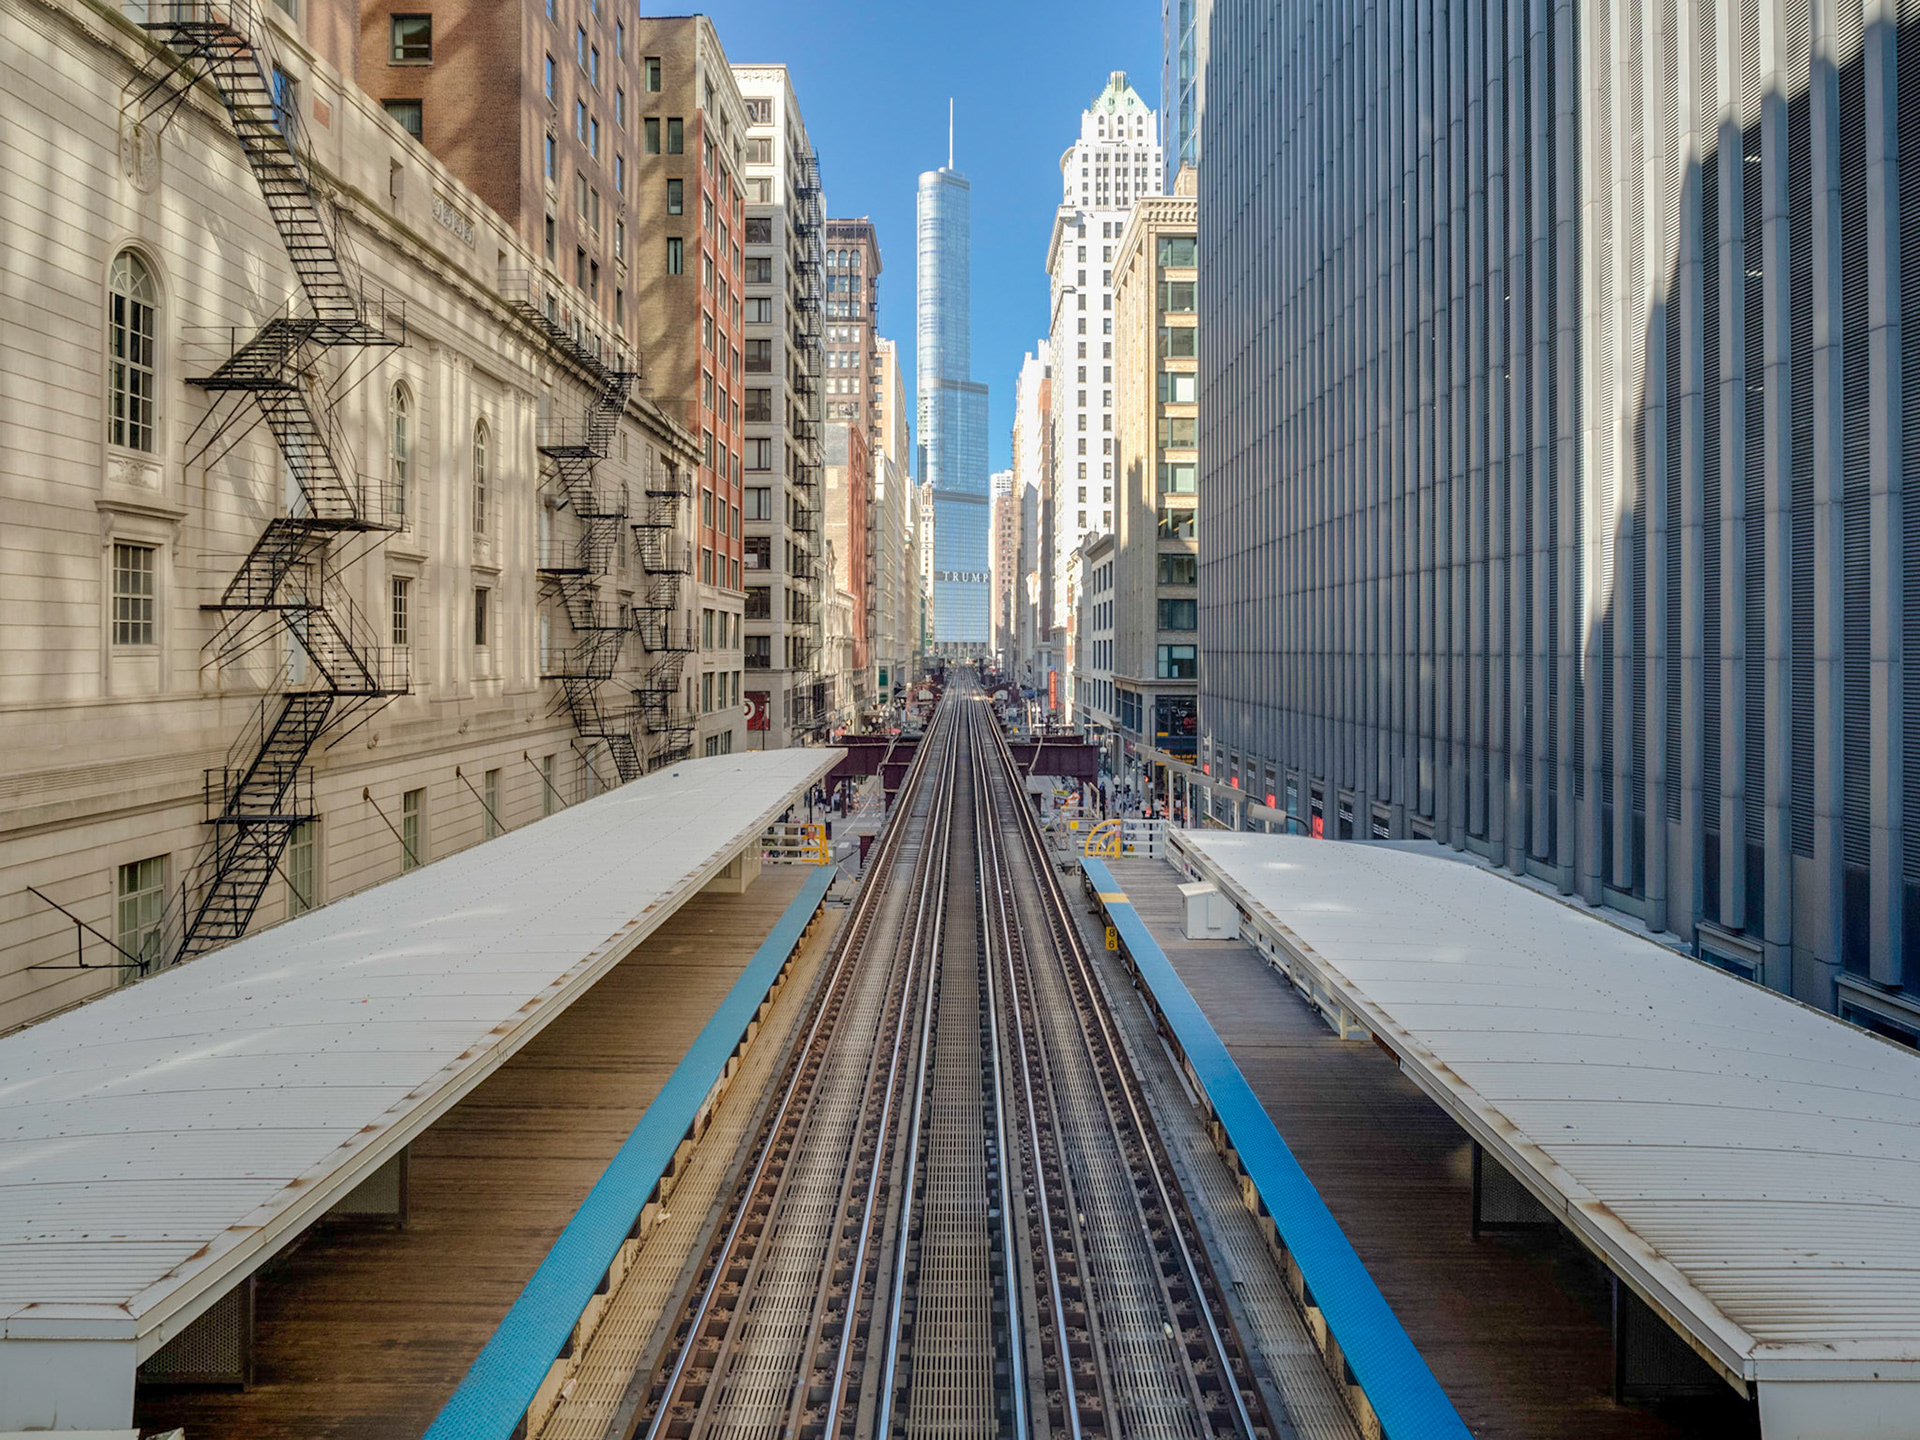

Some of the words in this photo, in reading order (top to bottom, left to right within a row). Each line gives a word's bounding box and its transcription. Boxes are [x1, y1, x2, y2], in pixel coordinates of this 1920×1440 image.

[943, 571, 988, 582] TRUMP
[1109, 929, 1115, 937] 8
[1108, 940, 1115, 948] 6
